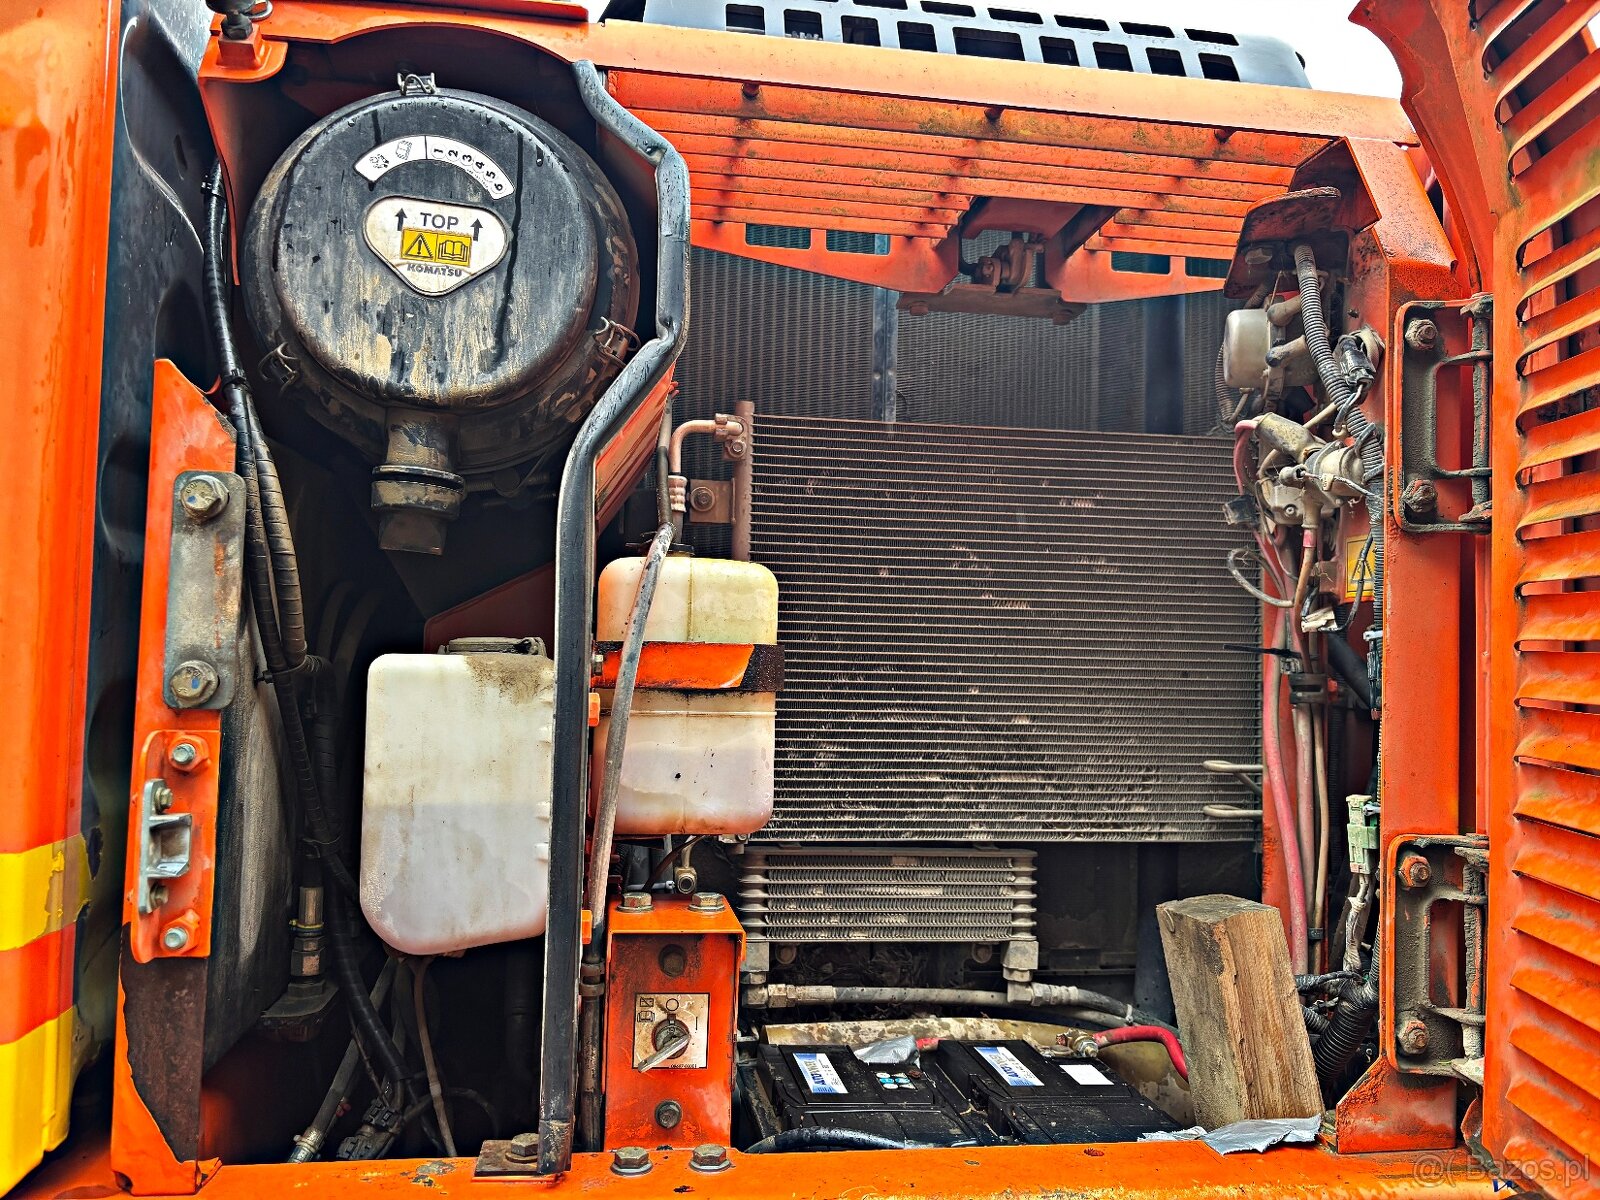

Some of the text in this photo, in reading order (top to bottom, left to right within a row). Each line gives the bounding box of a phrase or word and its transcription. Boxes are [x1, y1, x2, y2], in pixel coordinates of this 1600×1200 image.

[447, 150, 458, 158] 2
[462, 154, 472, 162] 3
[475, 161, 485, 170] 4
[486, 170, 496, 179] 5
[494, 183, 504, 192] 6
[420, 212, 459, 229] TOP
[407, 263, 462, 277] KOMATSU
